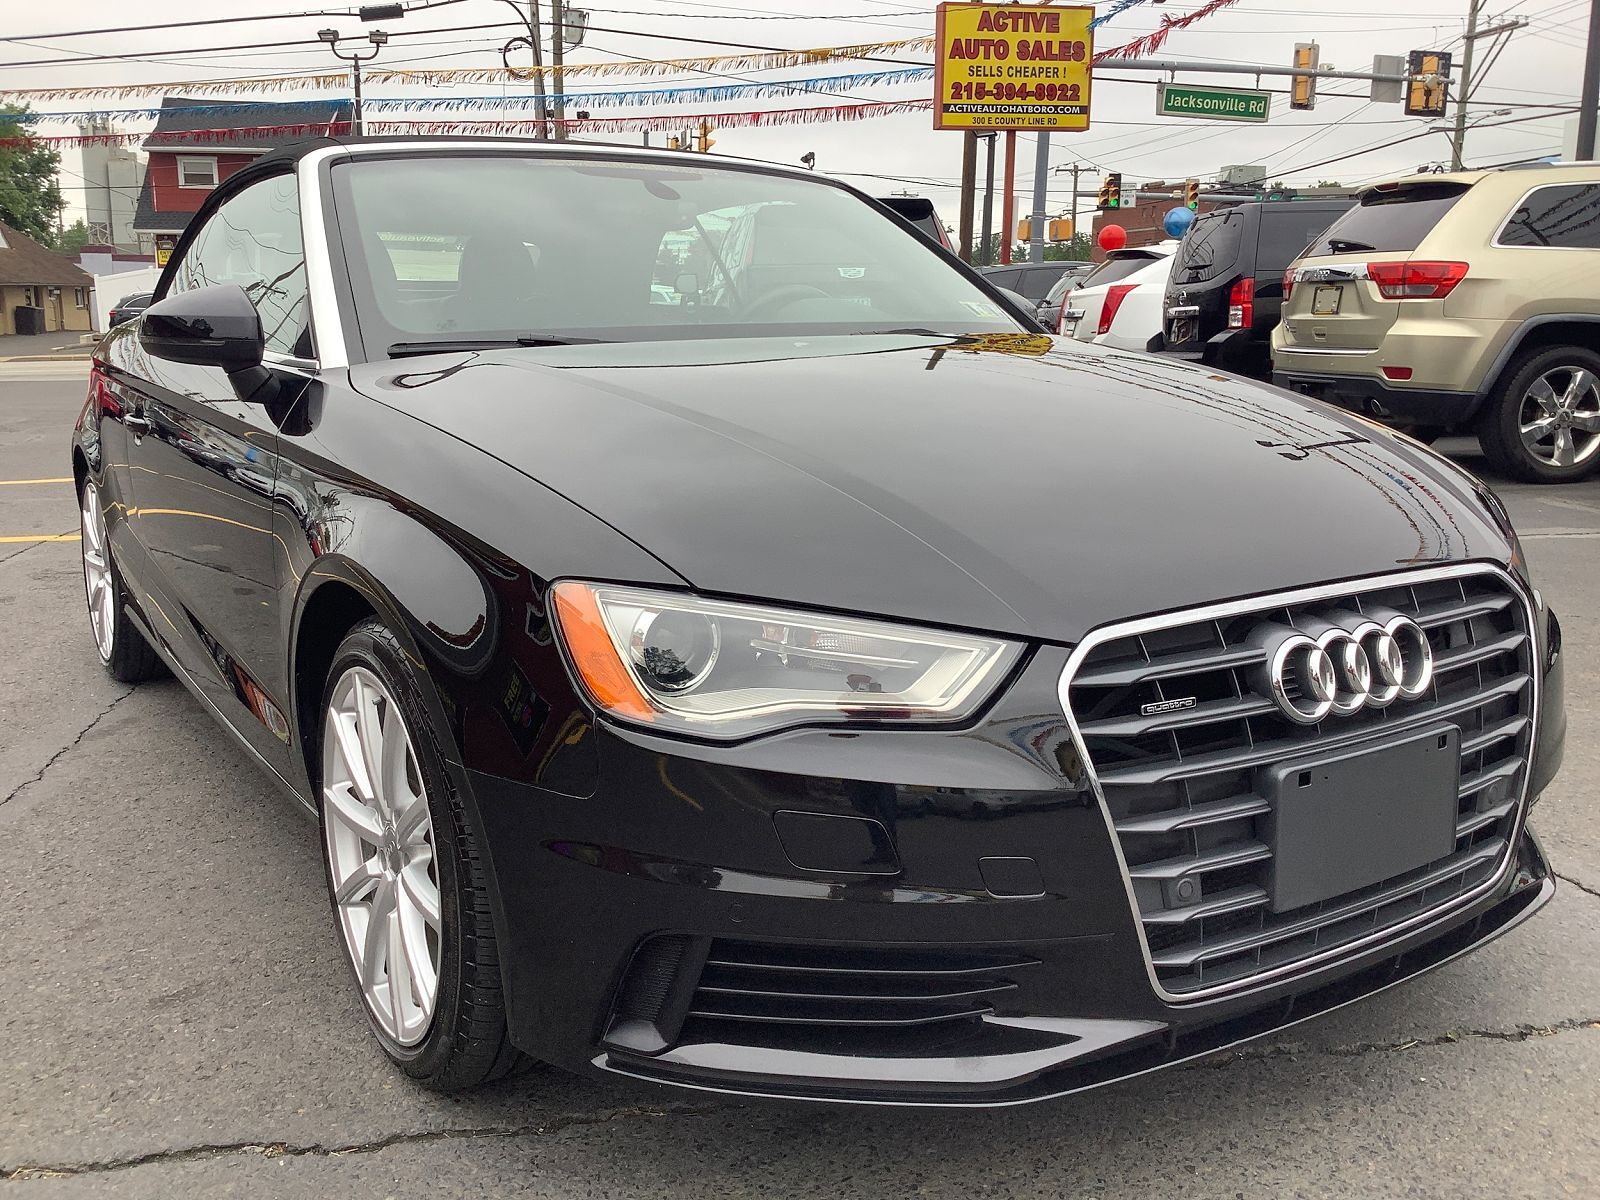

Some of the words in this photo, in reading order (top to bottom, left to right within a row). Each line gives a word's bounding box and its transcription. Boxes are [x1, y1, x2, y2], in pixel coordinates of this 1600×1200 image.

[977, 11, 1060, 33] ACTIVE
[949, 38, 1010, 60] AUTO
[1016, 39, 1086, 62] SALES
[968, 65, 1003, 78] SELLS
[1007, 66, 1060, 79] CHEAPER
[951, 81, 1081, 102] 215-394-8922
[949, 104, 1081, 114] ACTIVEAUTOHATBORO.COM
[1167, 94, 1246, 112] Jacksonville
[1249, 100, 1265, 113] Rd
[972, 116, 986, 125] 300
[987, 117, 993, 125] E
[994, 117, 1026, 125] COUNTY
[1047, 118, 1058, 126] RD
[1146, 700, 1193, 714] quattro
